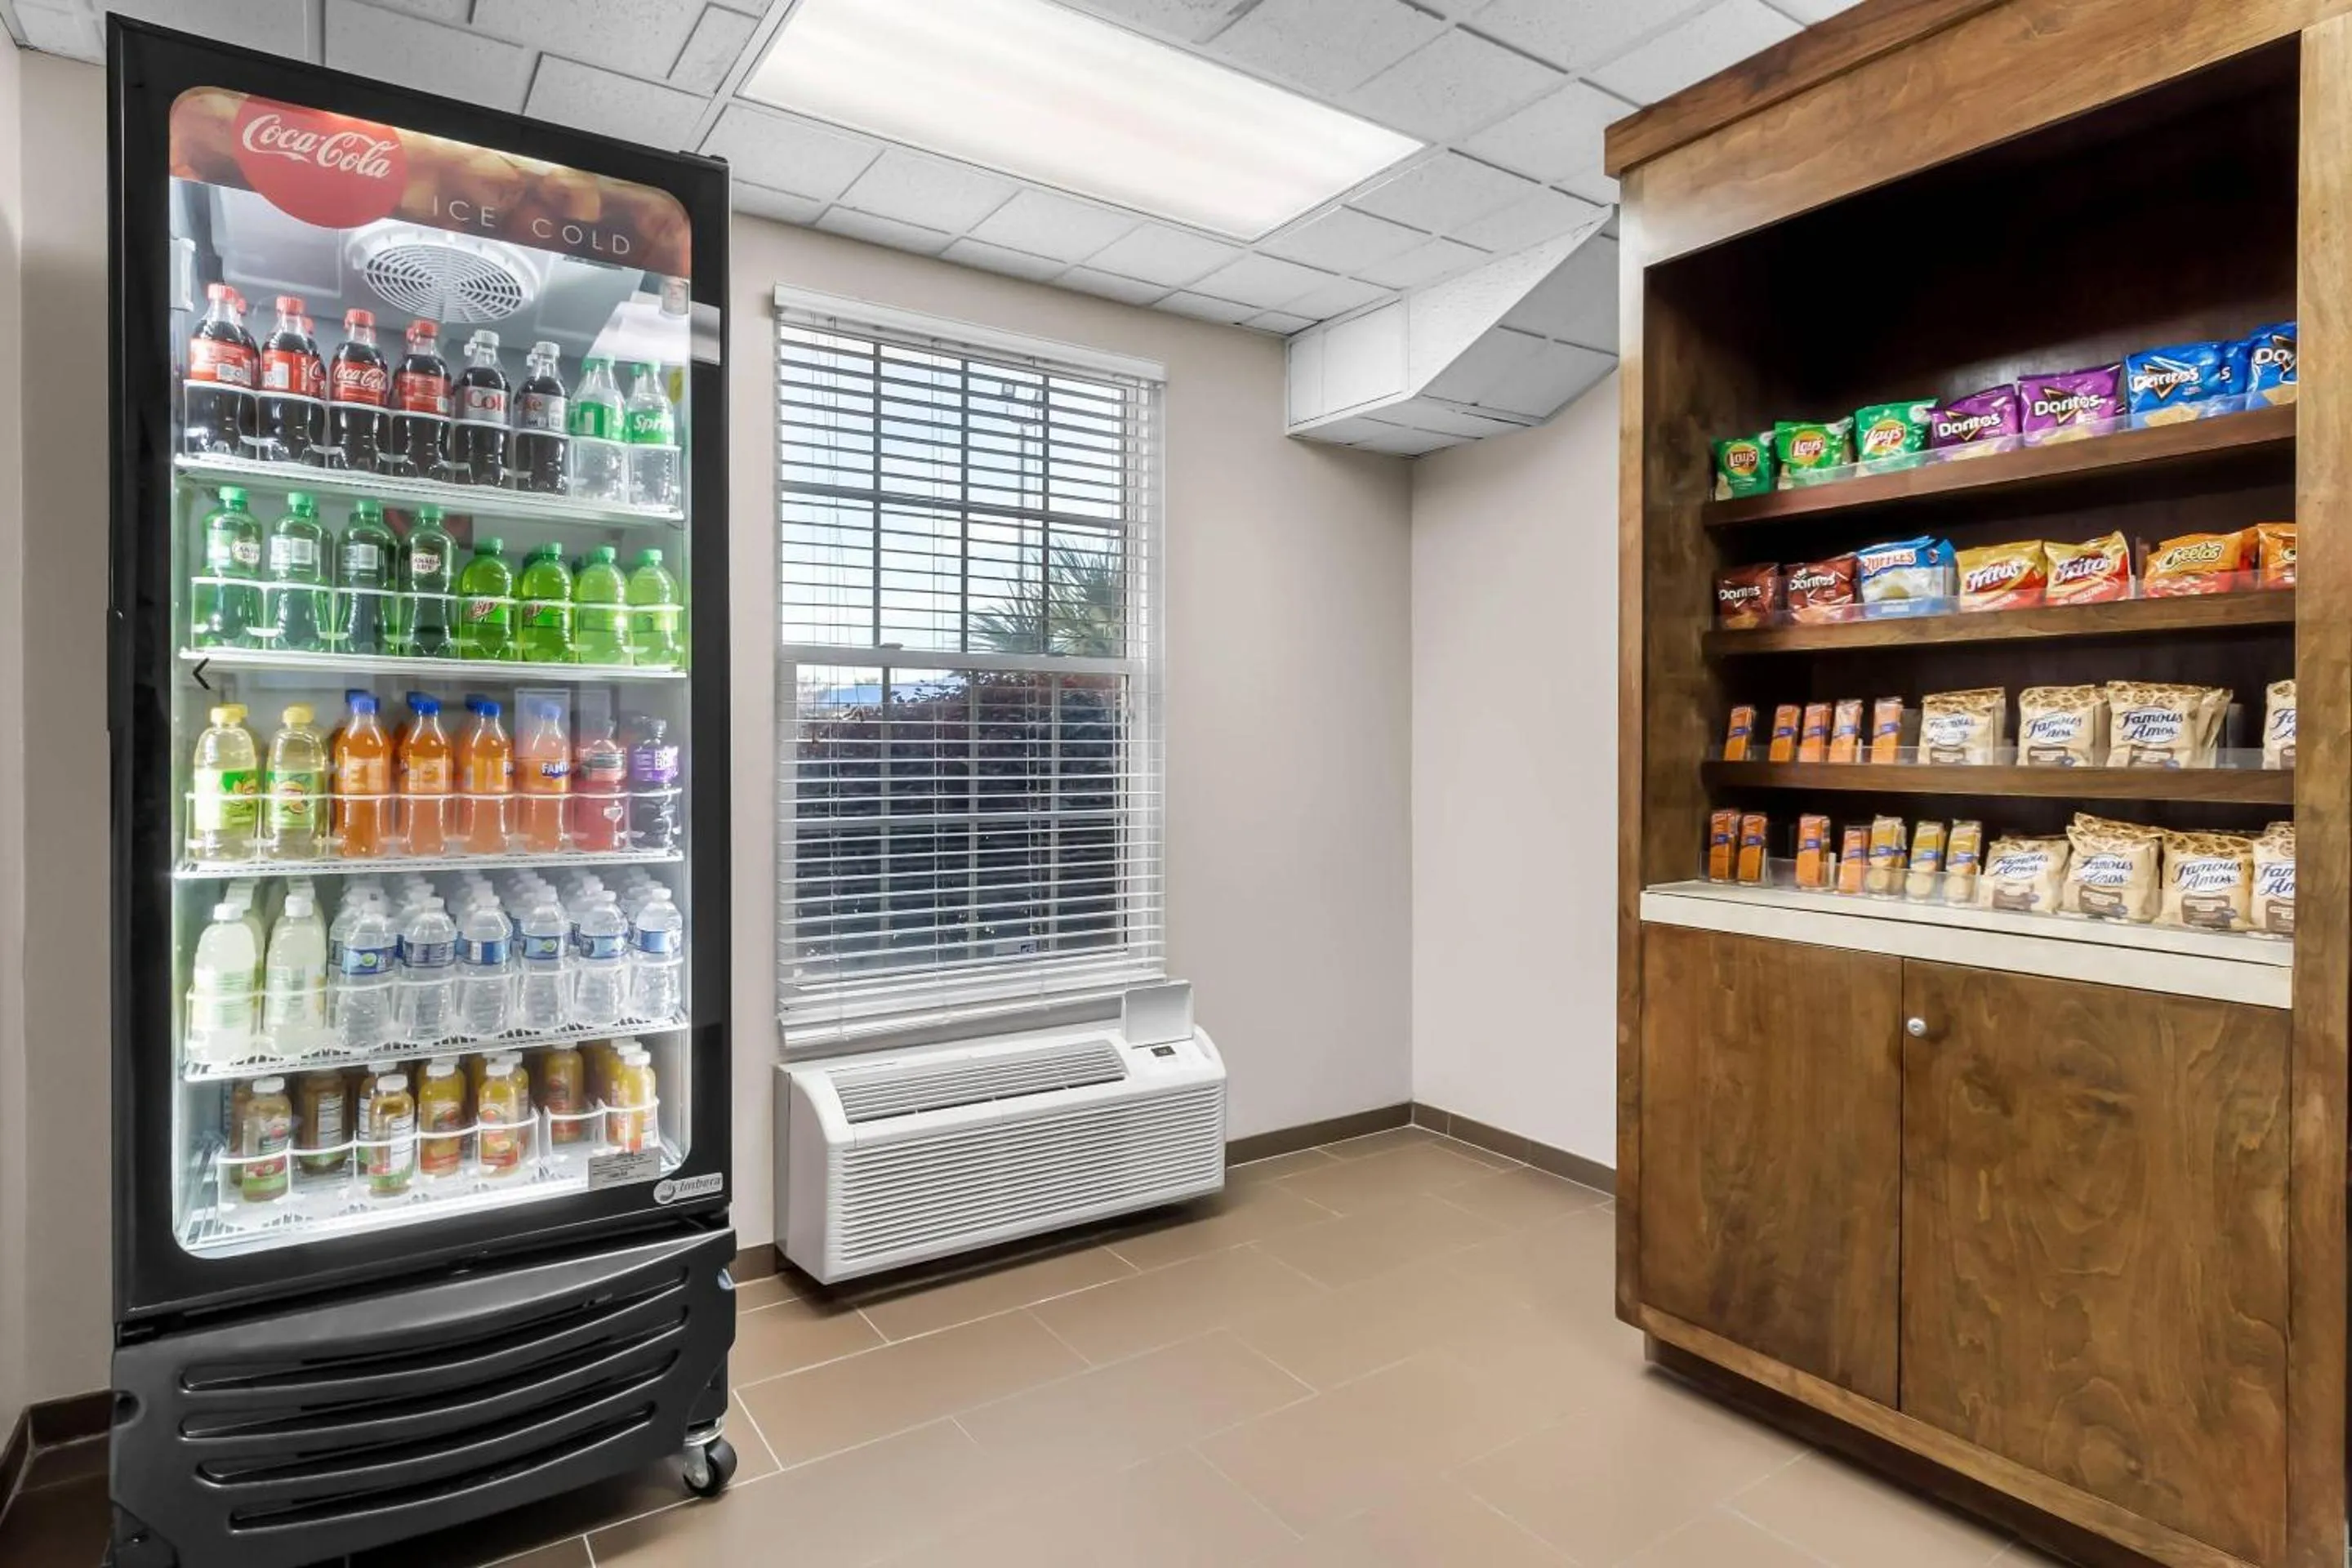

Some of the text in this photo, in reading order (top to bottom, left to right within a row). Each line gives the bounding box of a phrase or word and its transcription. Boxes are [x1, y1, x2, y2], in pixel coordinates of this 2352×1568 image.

[242, 114, 400, 179] Coca-Cola
[433, 194, 631, 255] ICE COLD
[2132, 368, 2199, 391] Doritos
[2034, 394, 2100, 416] Doritos
[1938, 412, 2001, 438] Doritos
[2158, 542, 2223, 569] Cheetos
[2117, 710, 2184, 729] Famous
[2171, 861, 2242, 884] Famous
